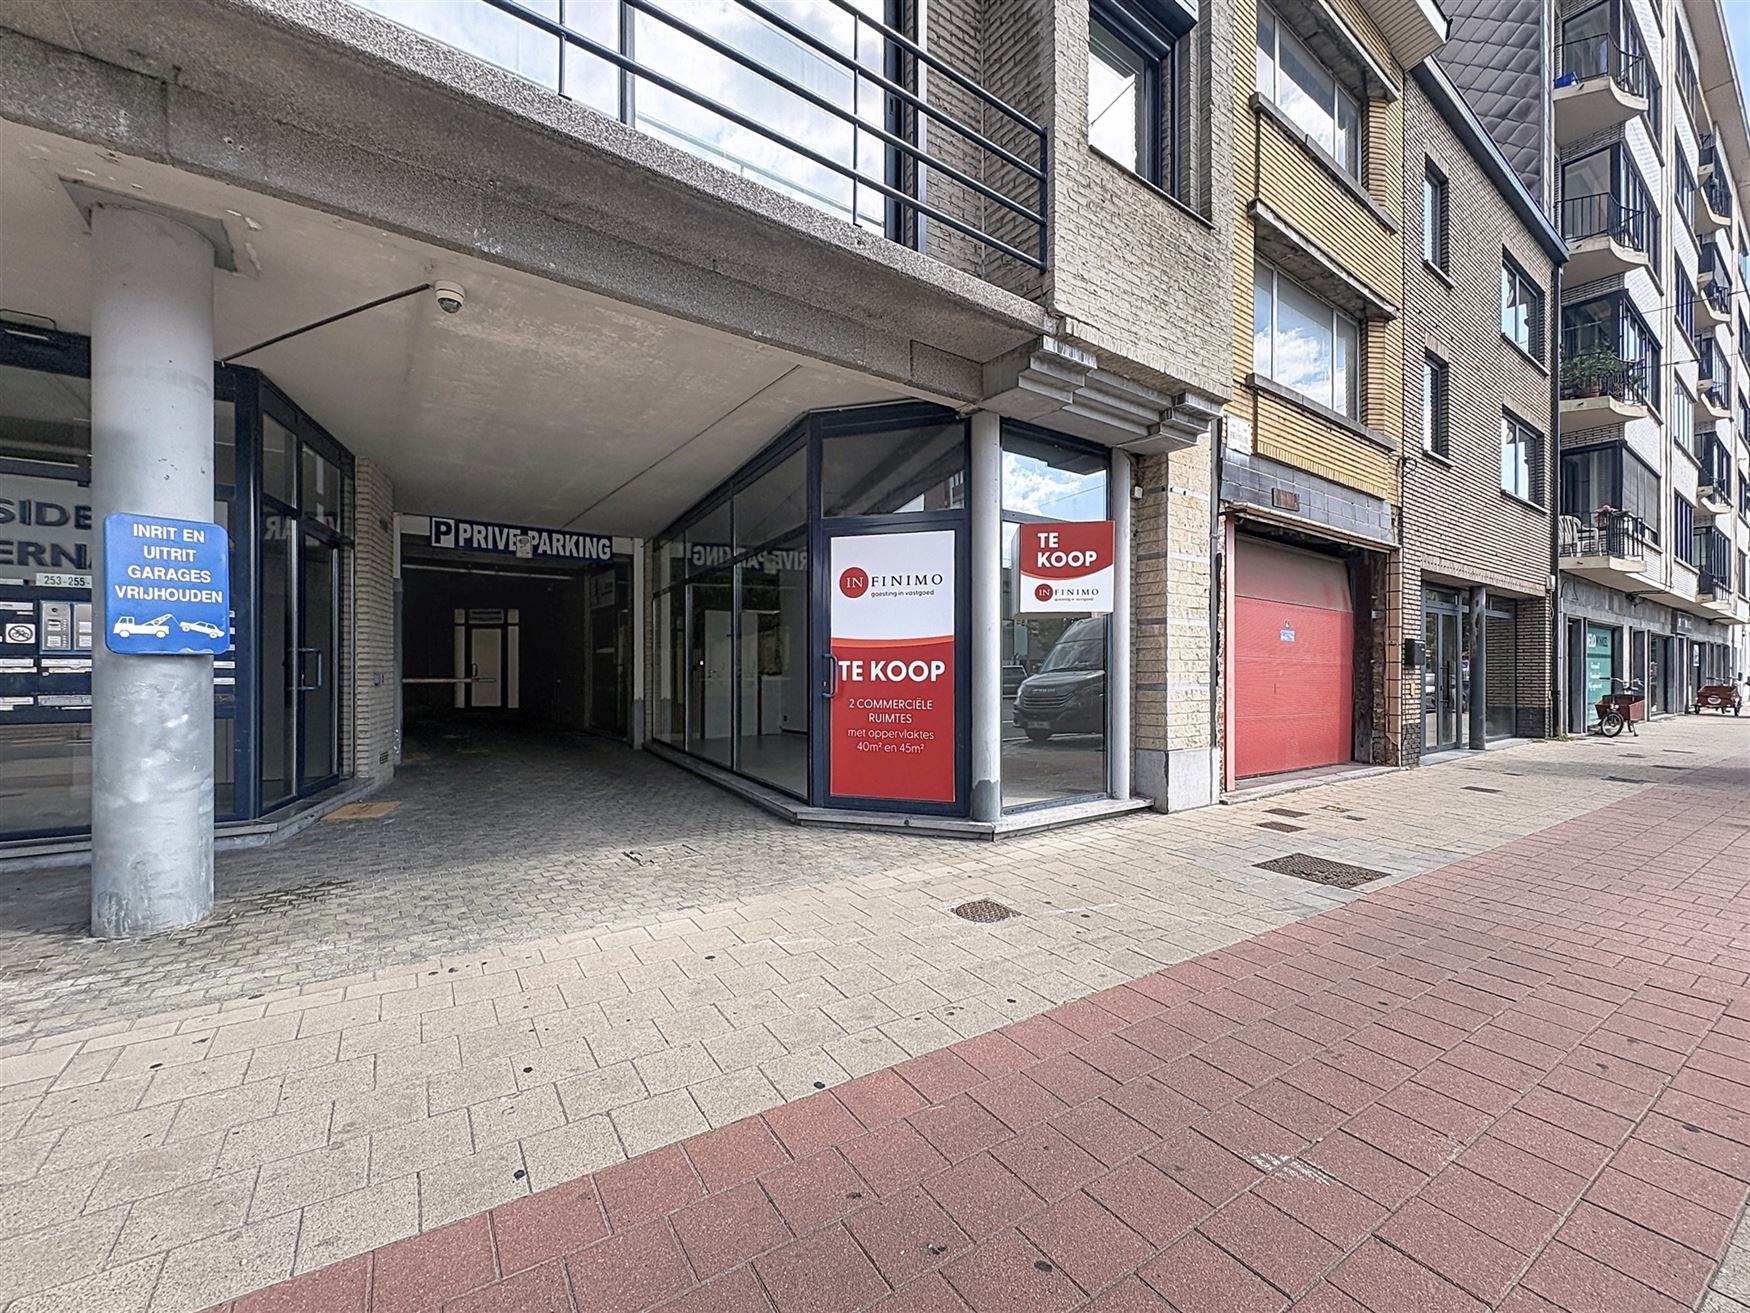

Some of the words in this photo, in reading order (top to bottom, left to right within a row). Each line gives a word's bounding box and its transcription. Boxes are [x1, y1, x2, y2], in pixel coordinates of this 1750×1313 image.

[133, 523, 177, 542] INRIT
[182, 528, 205, 543] EN
[1037, 532, 1059, 548] TE
[458, 523, 521, 552] PRIVE
[528, 531, 611, 560] PARKING
[143, 546, 197, 562] UITRIT
[1037, 550, 1097, 568] KOOP
[127, 565, 212, 583] GARAGES
[115, 585, 223, 604] VRIJHOUDEN
[905, 589, 935, 598] vastgoed
[838, 661, 864, 681] TE
[870, 660, 945, 682] KOOP
[848, 699, 855, 709] 2
[857, 697, 933, 710] COMMERCIËLE
[868, 712, 912, 724] RUIMTES
[847, 729, 867, 738] met
[868, 727, 934, 742] oppervlaktes
[857, 741, 882, 752] 40m²
[884, 744, 897, 752] en
[899, 742, 925, 753] 45m²
